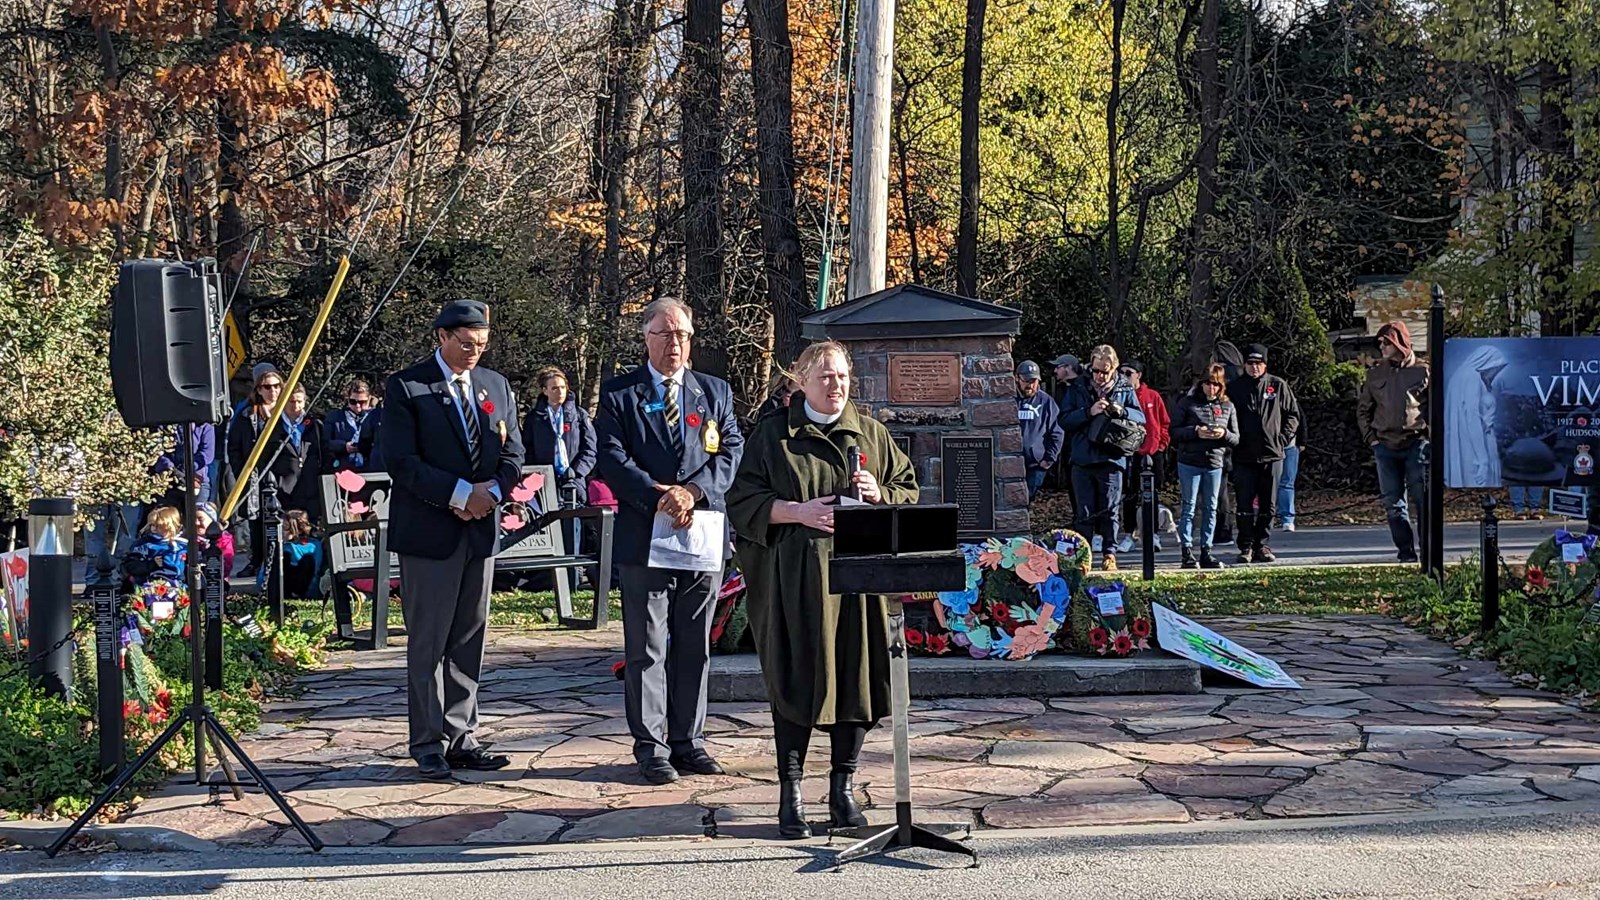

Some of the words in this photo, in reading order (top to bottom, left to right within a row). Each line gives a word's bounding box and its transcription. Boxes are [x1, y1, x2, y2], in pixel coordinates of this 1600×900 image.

[1561, 360, 1600, 374] PLAC
[1557, 417, 1574, 426] 1917
[1565, 428, 1600, 437] HUDSON
[530, 537, 546, 547] PAS
[351, 549, 371, 559] LES
[912, 591, 938, 600] CANAD
